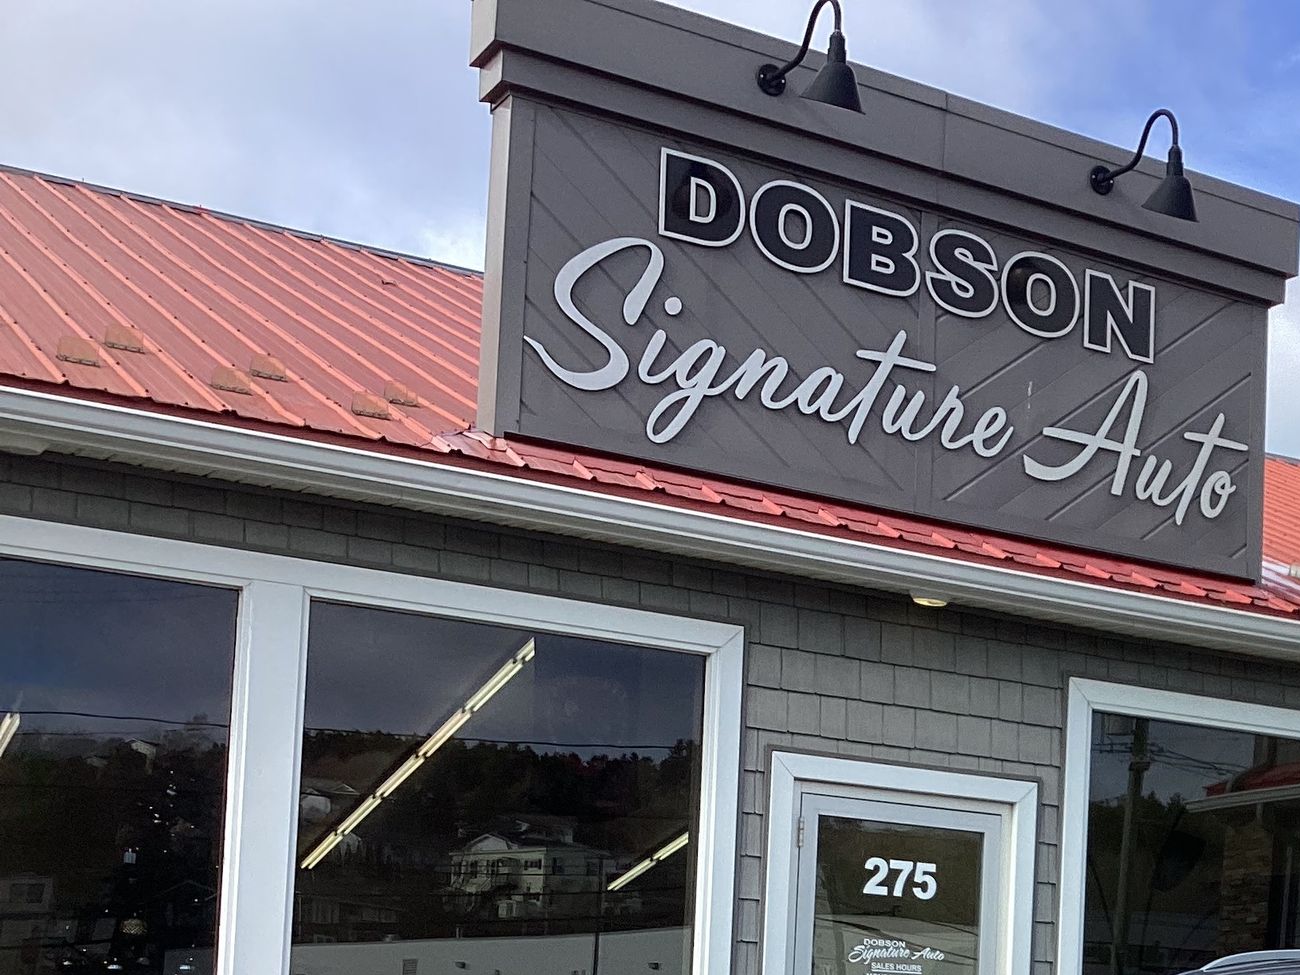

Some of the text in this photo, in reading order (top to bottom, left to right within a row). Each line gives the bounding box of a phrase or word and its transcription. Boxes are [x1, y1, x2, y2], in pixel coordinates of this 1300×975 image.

[658, 146, 1156, 364] DOBSON
[523, 236, 1249, 527] Signature Auto
[862, 856, 938, 900] 275
[848, 944, 945, 965] Signature Auto
[863, 938, 906, 948] DOBSON
[871, 962, 922, 971] SALES HOURS
